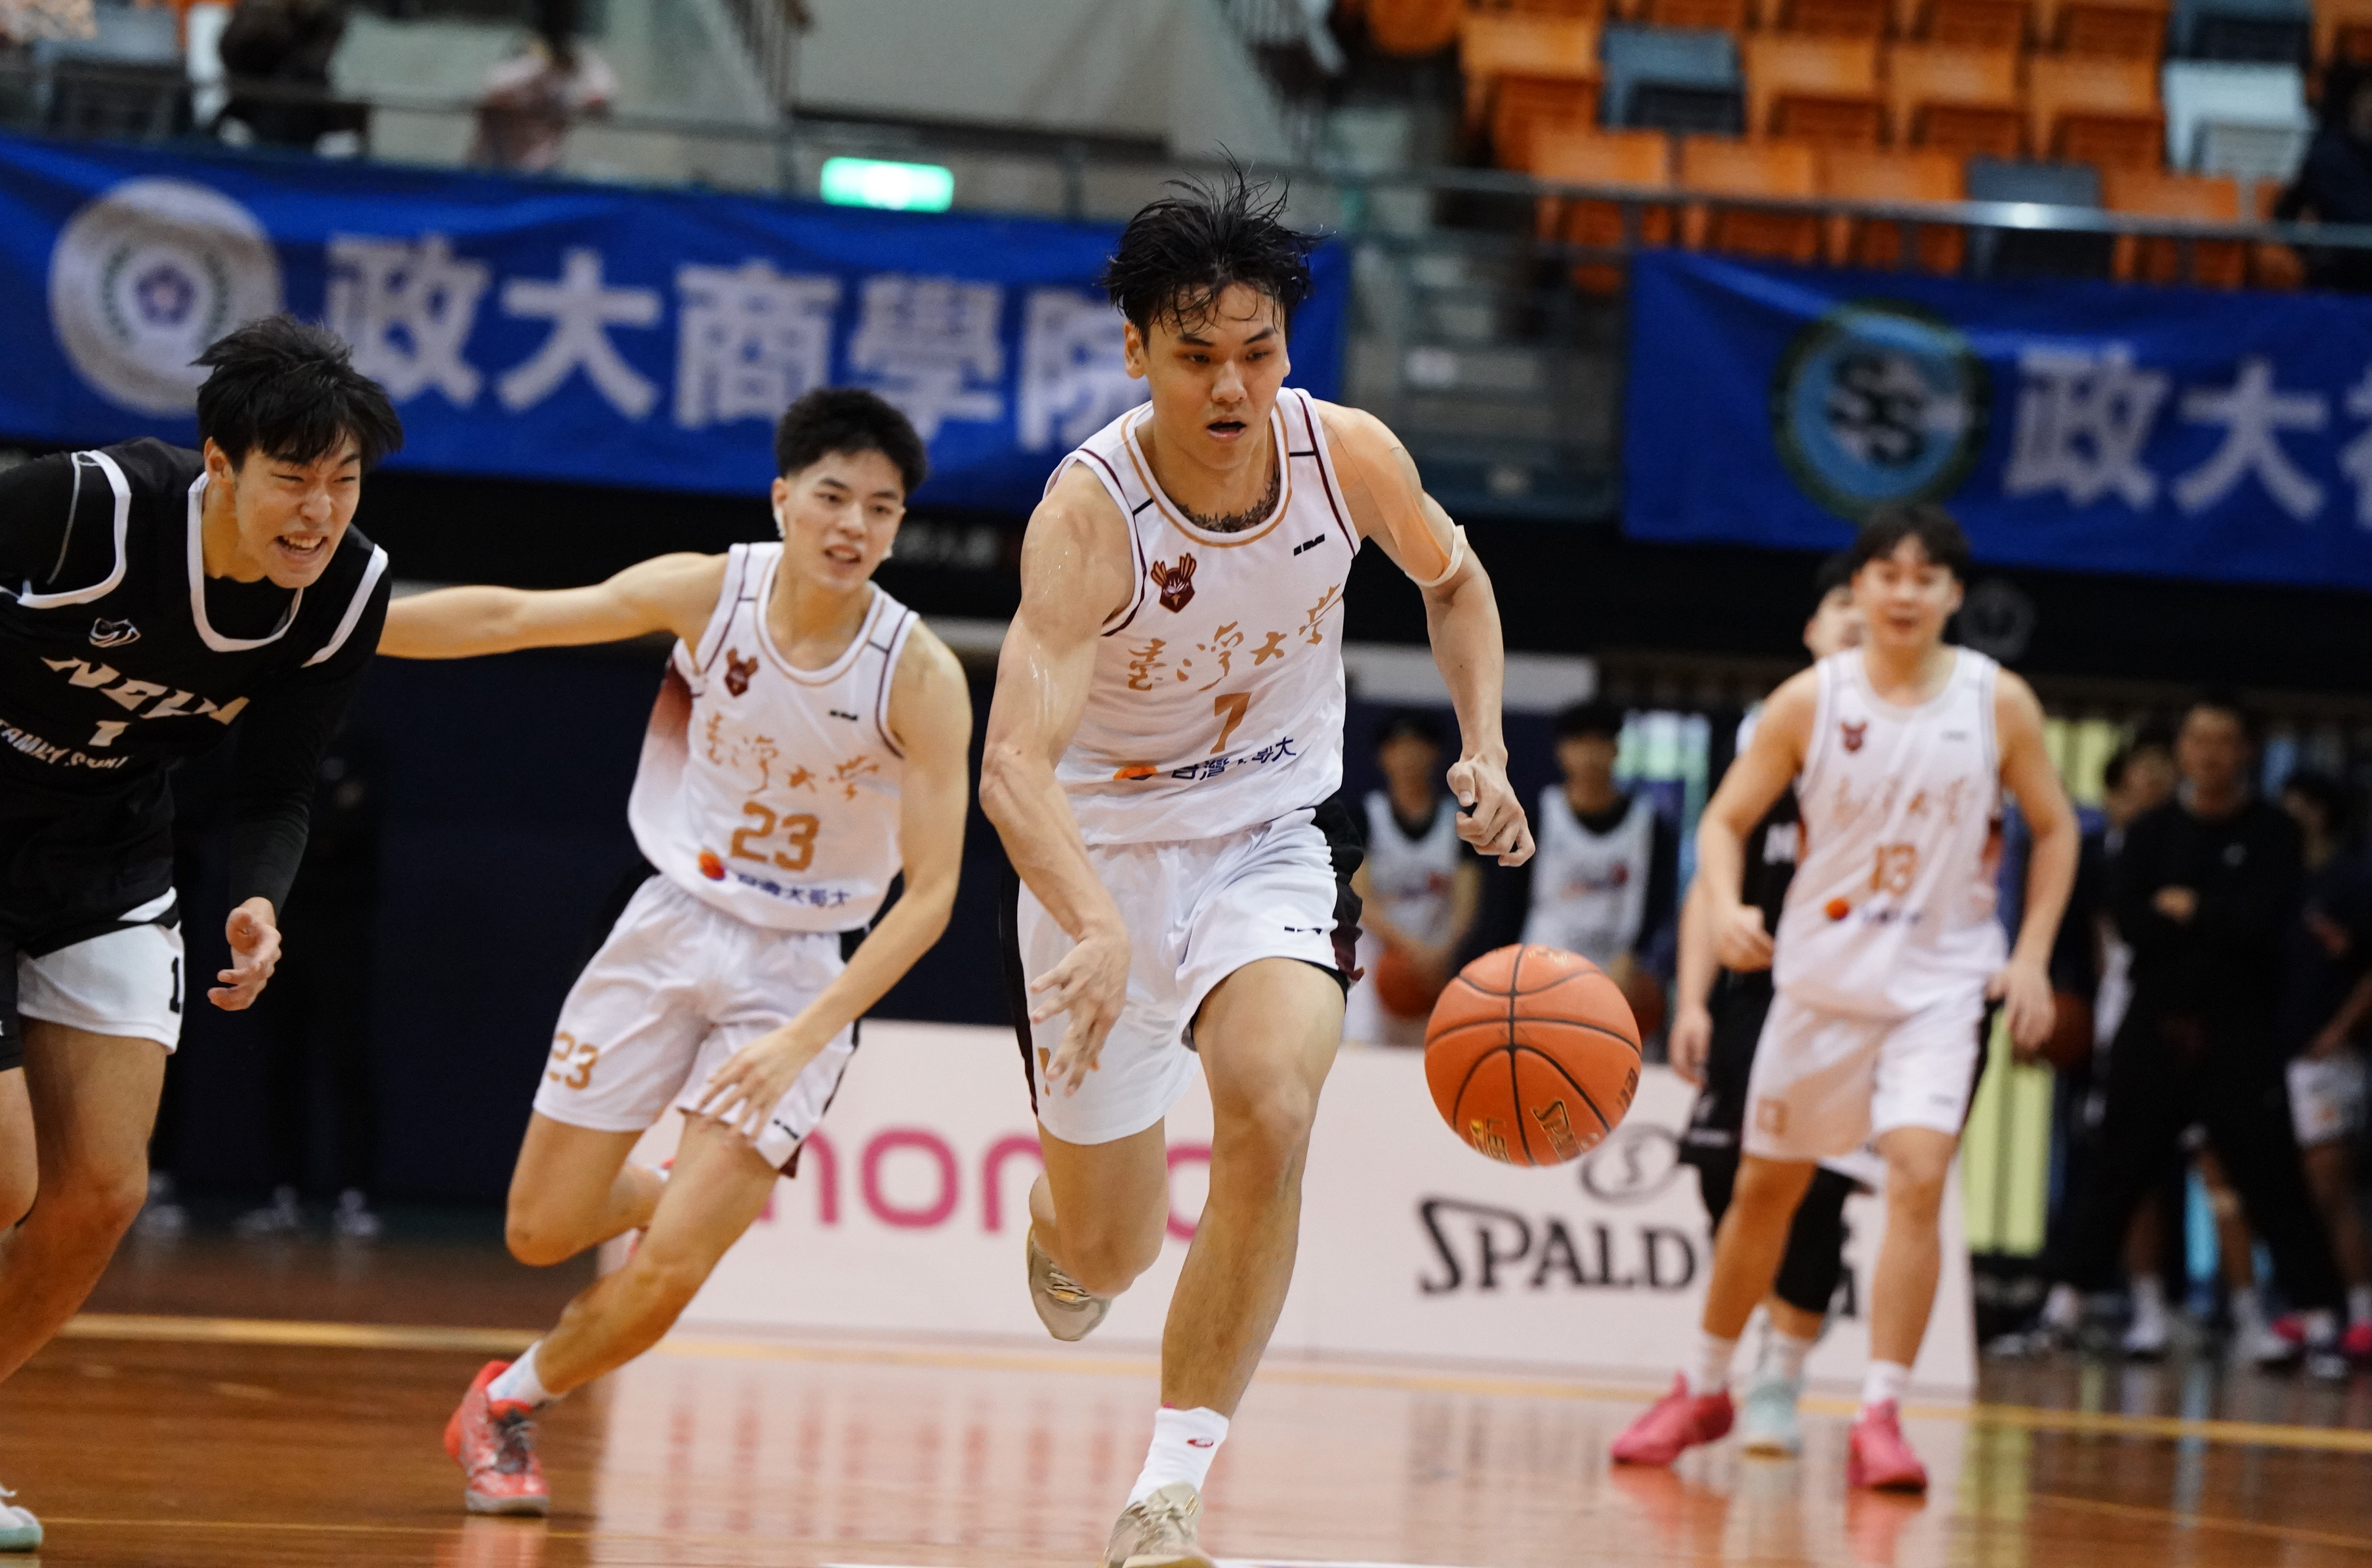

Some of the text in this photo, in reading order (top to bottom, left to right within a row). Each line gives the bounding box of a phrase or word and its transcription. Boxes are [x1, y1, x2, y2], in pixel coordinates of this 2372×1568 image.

[1210, 692, 1252, 754] 7
[1171, 736, 1297, 781] 台灣哥大
[730, 801, 820, 873] 23
[169, 957, 180, 1014] 1
